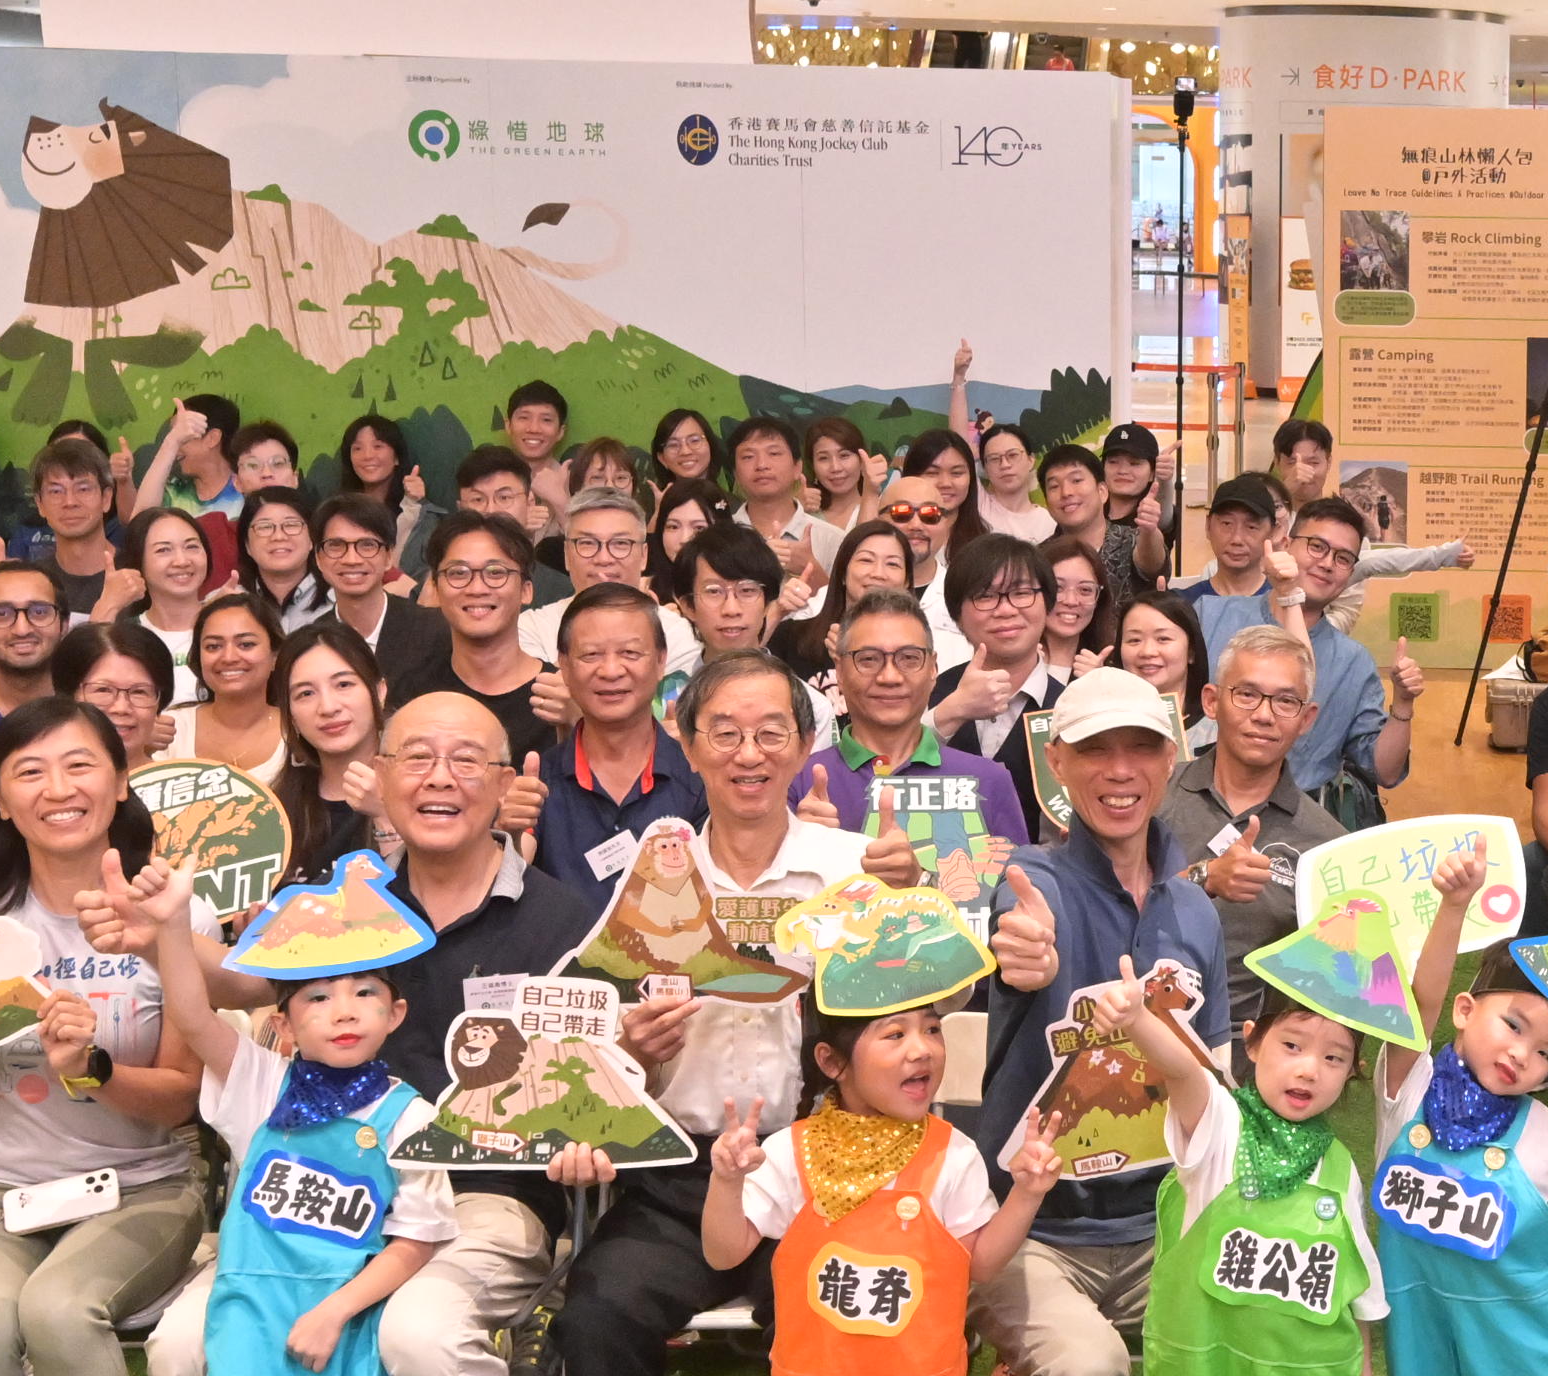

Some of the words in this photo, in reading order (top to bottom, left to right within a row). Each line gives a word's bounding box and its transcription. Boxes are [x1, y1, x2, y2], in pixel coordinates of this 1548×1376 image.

[1314, 64, 1364, 89] 食好
[468, 120, 605, 143] 綠惜地球
[728, 117, 930, 135] 香港賽馬會慈善信託基金
[470, 147, 496, 155] THE
[503, 147, 551, 156] GREEN
[558, 148, 606, 157] EARTH
[728, 136, 751, 149] The
[753, 137, 785, 152] Hong
[788, 137, 817, 152] Kong
[819, 138, 859, 153] Jockey
[861, 138, 888, 151] Club
[1011, 142, 1042, 151] YEARS
[728, 153, 779, 167] Charities
[782, 154, 813, 168] Trust
[1451, 232, 1481, 244] Rock
[1485, 233, 1542, 247] Climbing
[1377, 348, 1434, 364] Camping
[1461, 473, 1489, 485] Trail
[870, 775, 977, 812] 行正路
[193, 853, 281, 915] NT
[523, 986, 608, 1011] 自己垃圾
[521, 1011, 606, 1037] 自己帶走
[1054, 1027, 1130, 1053] 避免山
[476, 1133, 511, 1148] 獅子山
[251, 1162, 376, 1240] 馬鞍山
[1384, 1170, 1499, 1243] 獅子山
[1219, 1230, 1337, 1312] 雞公嶺
[818, 1257, 912, 1324] 龍脊
